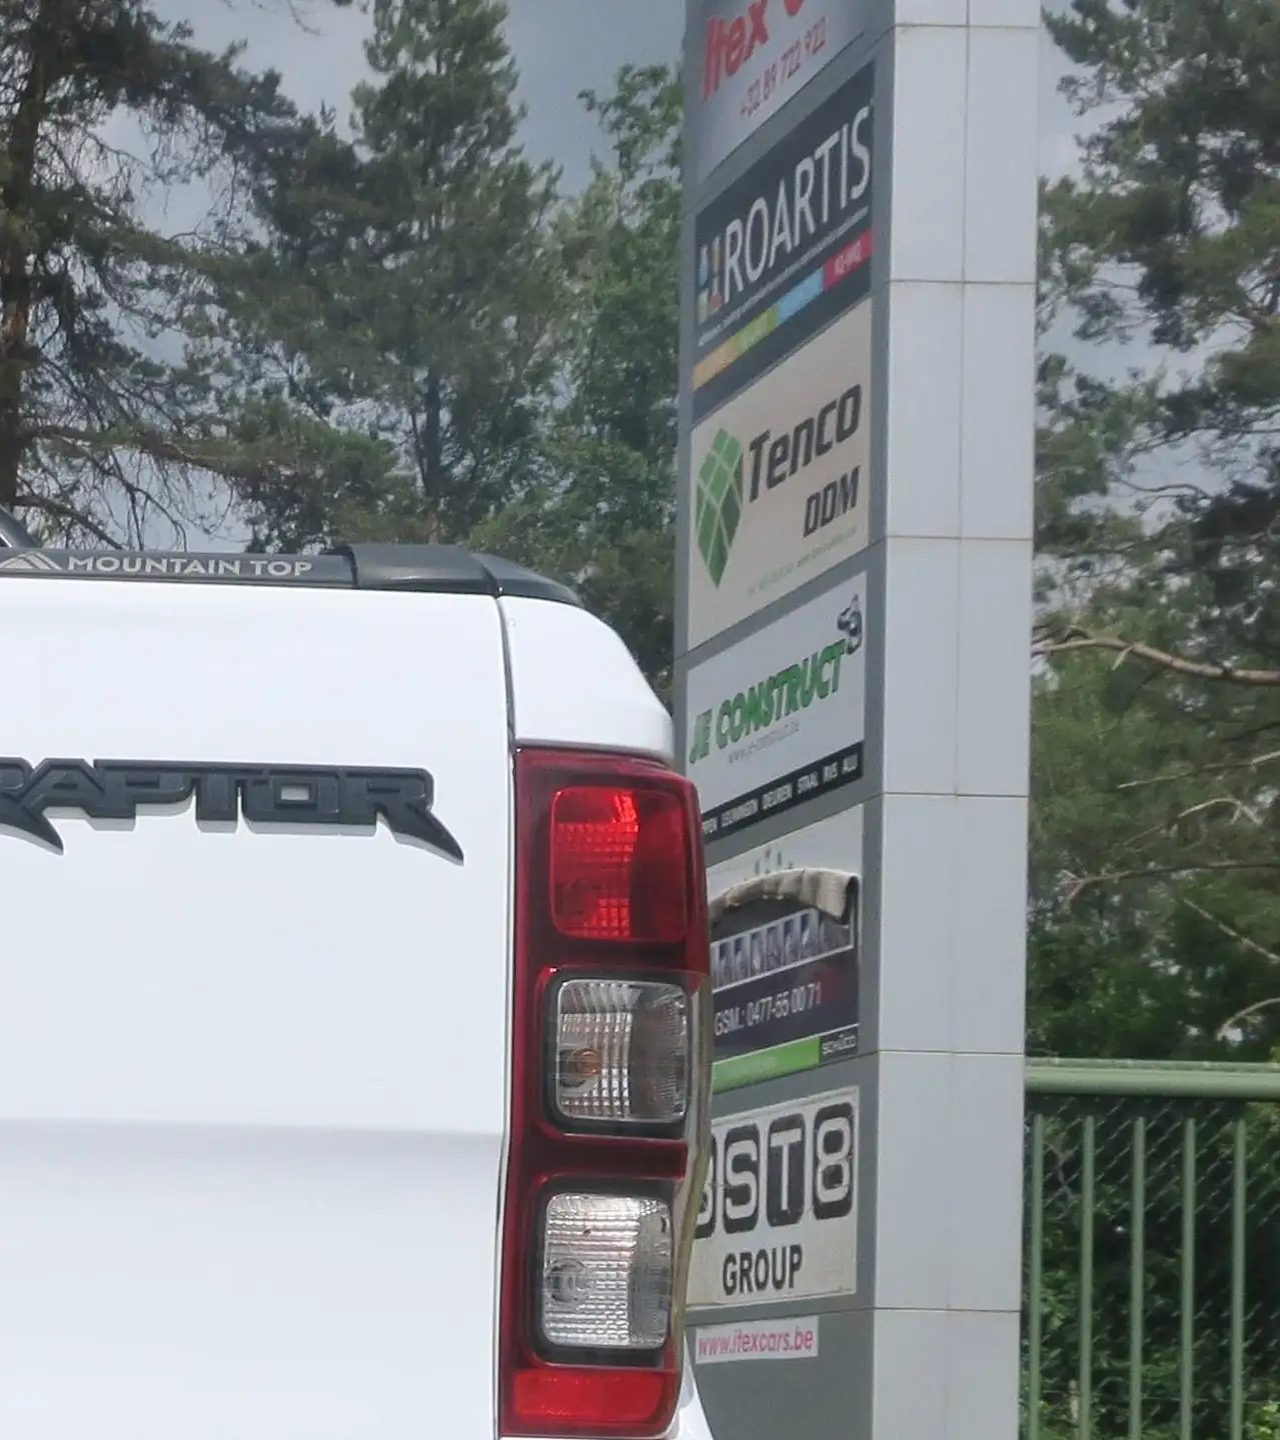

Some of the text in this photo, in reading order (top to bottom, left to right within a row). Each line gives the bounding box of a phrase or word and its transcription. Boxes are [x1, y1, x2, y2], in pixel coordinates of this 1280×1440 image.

[67, 555, 313, 577] MOUNTAIN TOP
[715, 638, 846, 749] CONSTRUCT
[722, 1244, 804, 1296] GROUP
